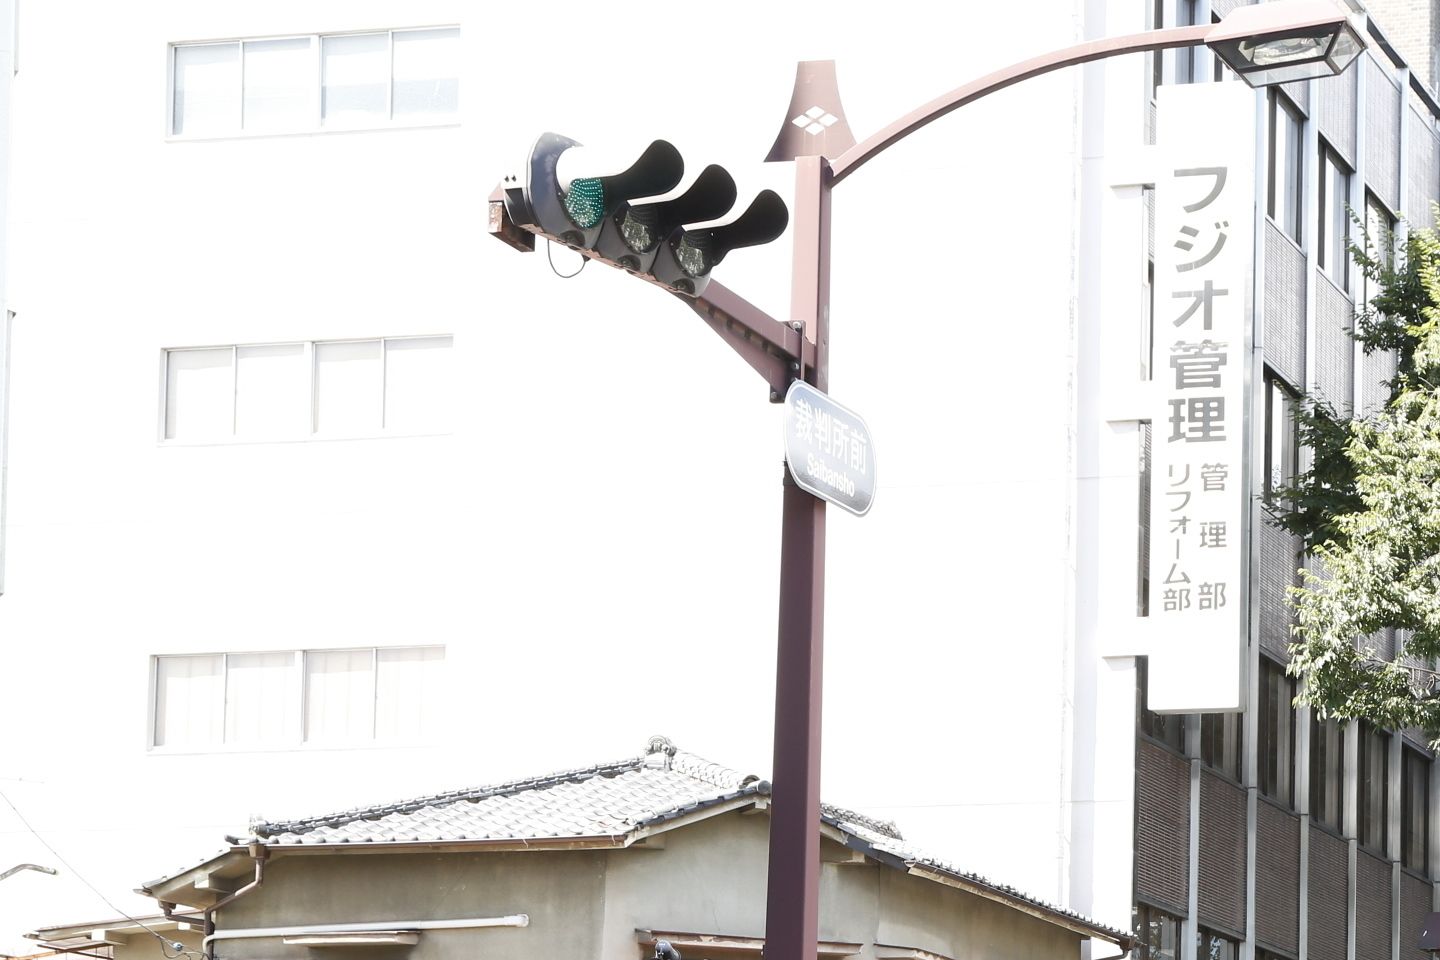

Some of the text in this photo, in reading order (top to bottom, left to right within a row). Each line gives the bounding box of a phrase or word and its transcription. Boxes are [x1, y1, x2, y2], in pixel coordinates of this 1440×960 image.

[1168, 166, 1229, 444] フジオ管理
[1163, 464, 1192, 612] リフォーム部
[1199, 462, 1227, 611] 管理部
